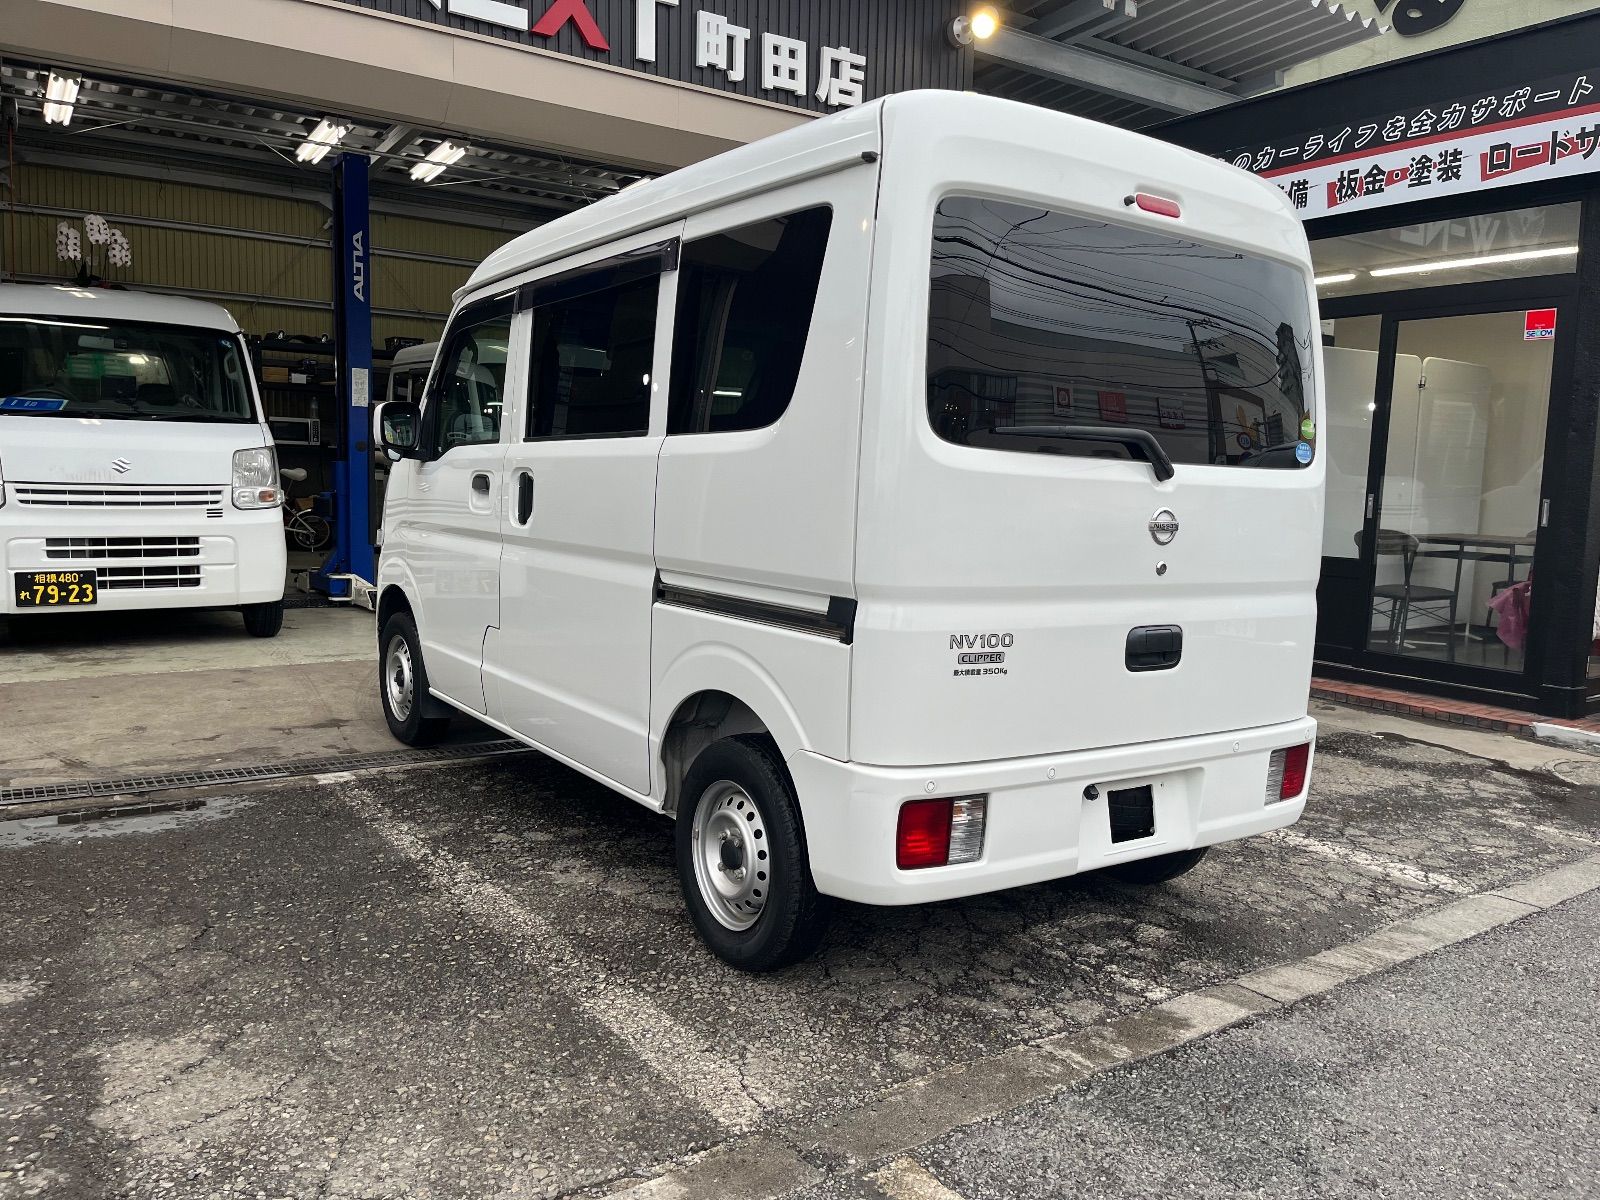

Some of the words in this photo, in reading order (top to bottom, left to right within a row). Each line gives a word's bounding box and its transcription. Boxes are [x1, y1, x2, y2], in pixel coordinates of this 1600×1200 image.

[696, 10, 867, 107] 町田店
[1217, 76, 1593, 172] のカーライフを全力サポート
[1277, 178, 1309, 210] 備
[1337, 148, 1463, 204] 板金・塗装
[1526, 330, 1553, 338] SECOM
[20, 590, 31, 601] れ
[33, 583, 93, 605] 79-23
[949, 632, 1014, 650] NV100
[961, 653, 1002, 663] CLIPPER
